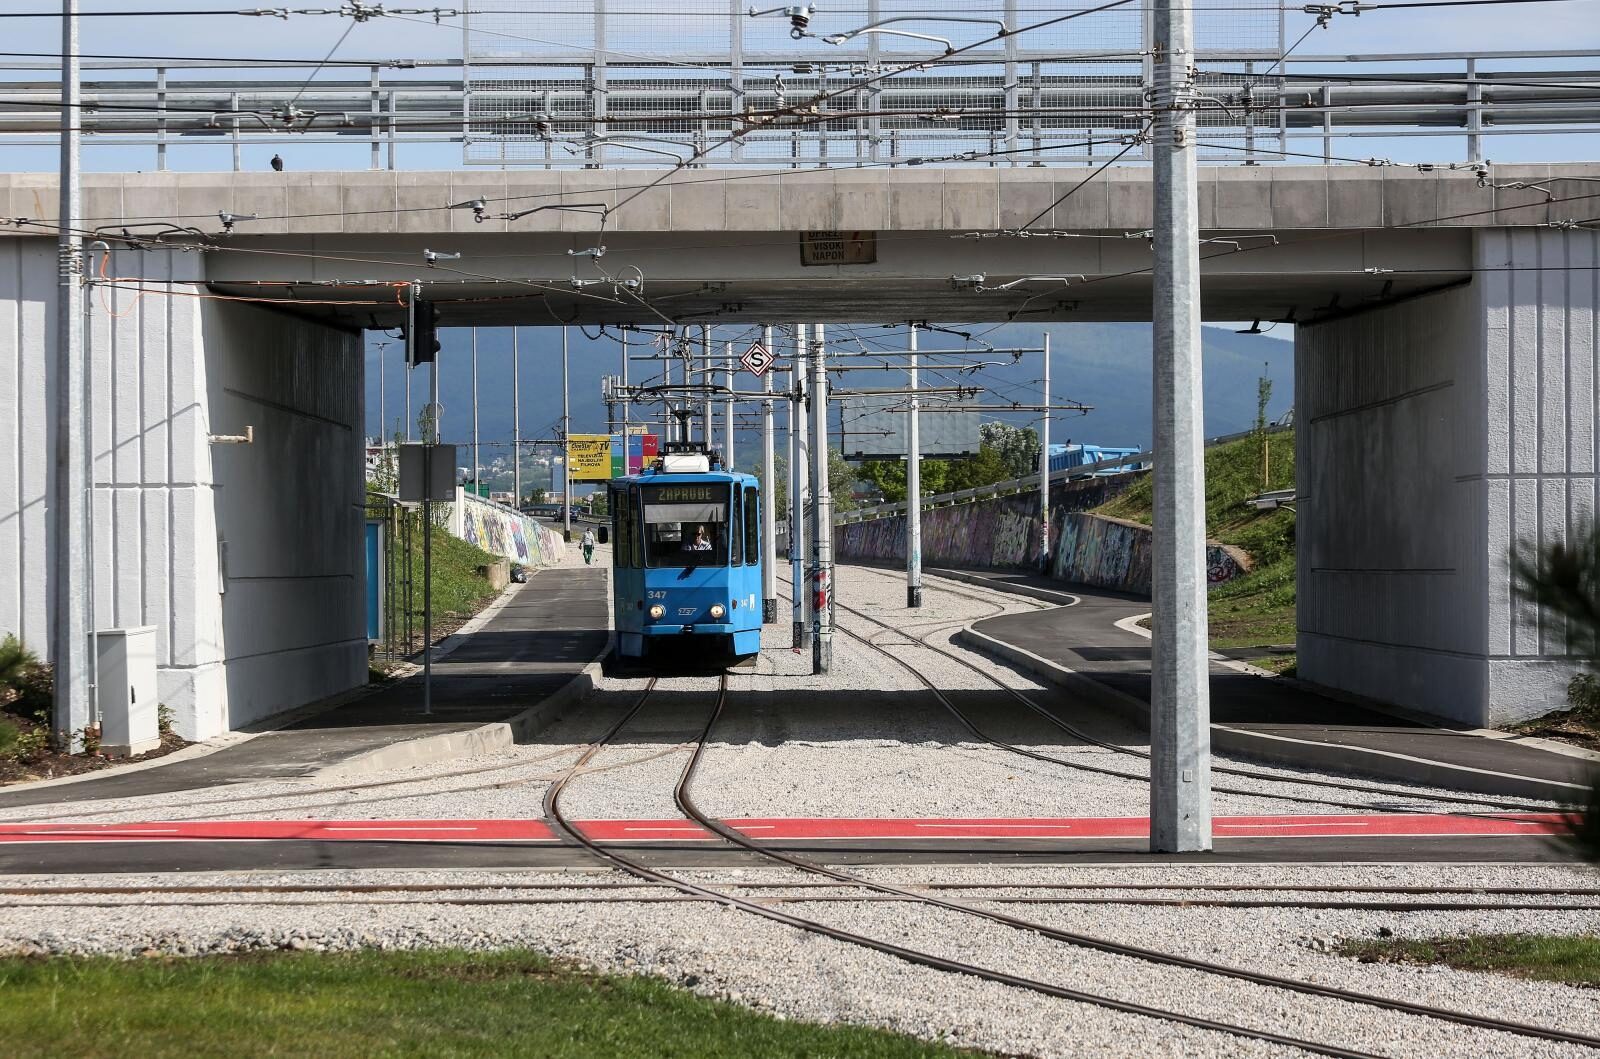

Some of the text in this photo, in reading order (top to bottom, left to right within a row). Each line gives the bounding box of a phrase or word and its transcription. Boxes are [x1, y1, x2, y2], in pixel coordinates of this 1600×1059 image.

[814, 241, 844, 250] VISOKI
[812, 251, 845, 260] NAPON
[751, 352, 764, 367] S
[599, 441, 610, 450] TV
[647, 590, 667, 599] 347
[678, 607, 697, 615] ZET
